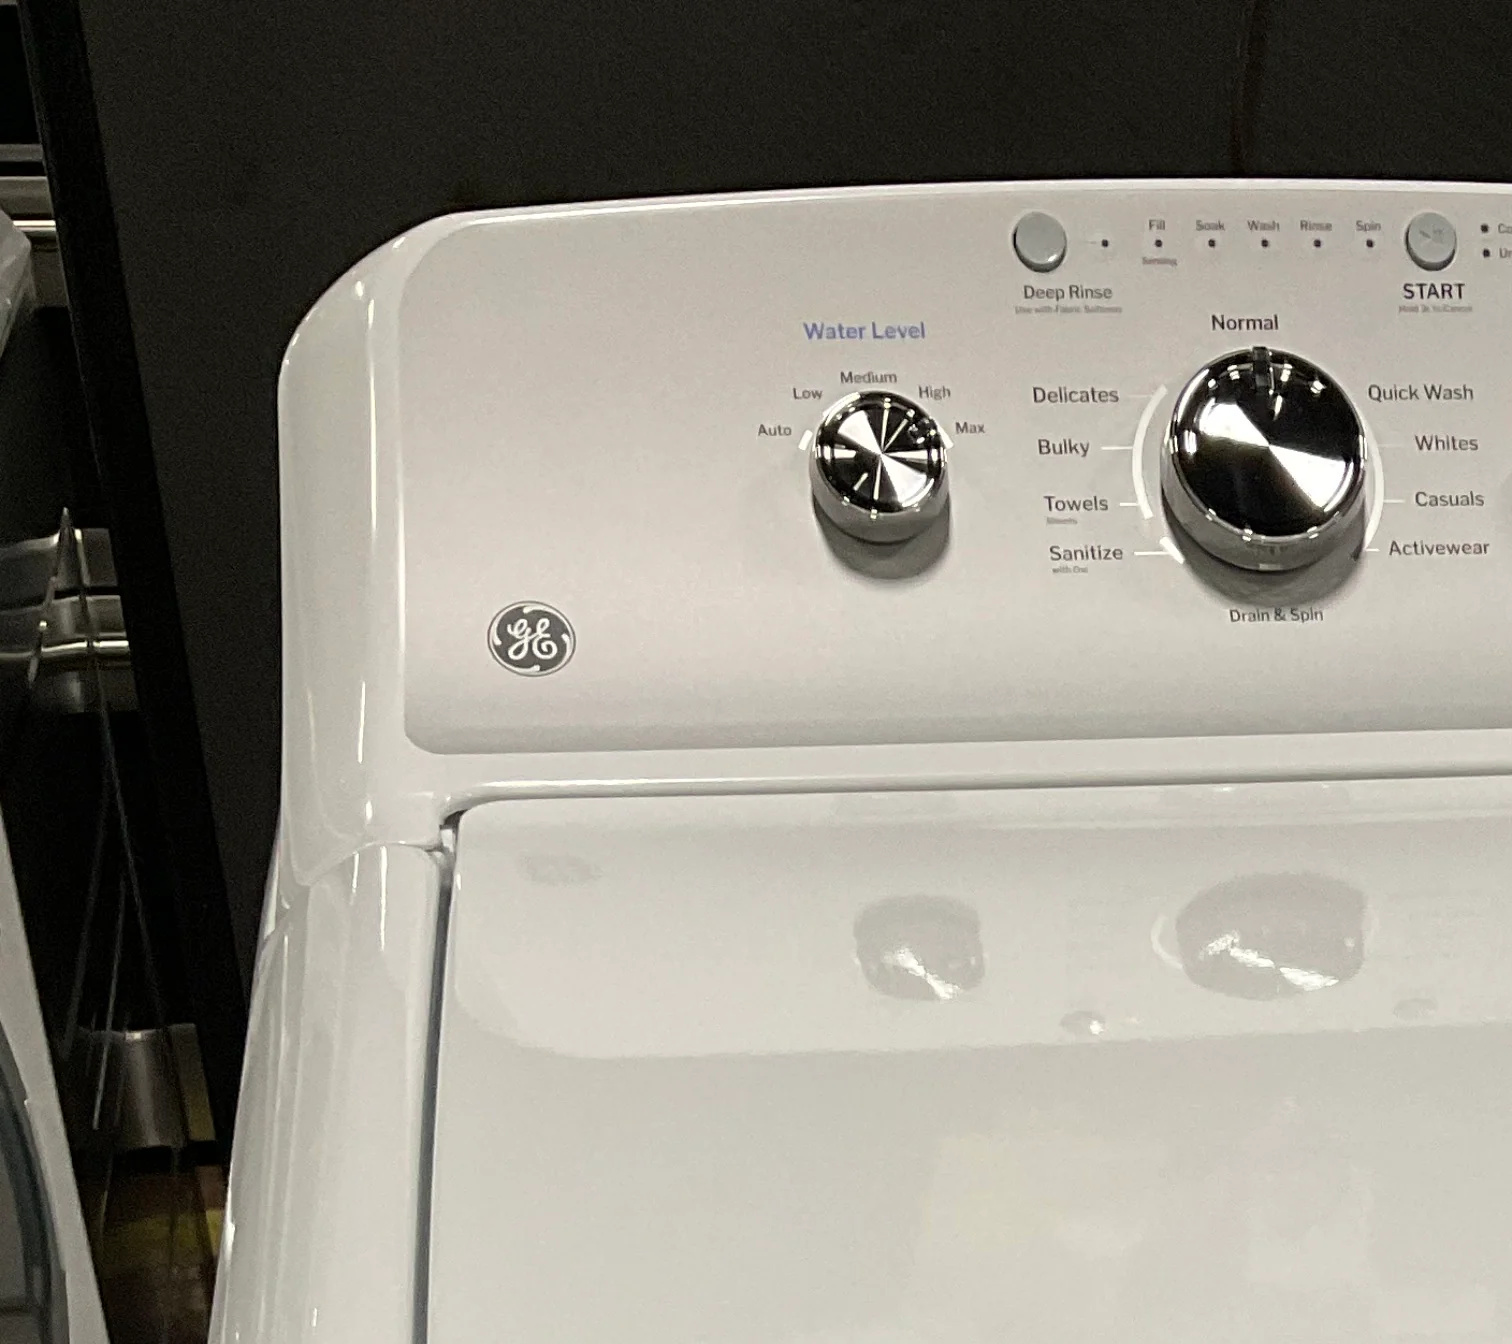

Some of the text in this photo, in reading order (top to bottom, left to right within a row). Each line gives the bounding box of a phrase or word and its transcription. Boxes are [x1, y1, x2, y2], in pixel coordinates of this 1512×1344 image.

[1148, 219, 1166, 231] Fill
[1195, 219, 1226, 232] Soak
[1247, 219, 1281, 232] Wash
[1299, 219, 1333, 232] Rinse
[1355, 219, 1382, 233] Spin
[1023, 283, 1114, 302] Deep Rinse
[1402, 283, 1466, 300] START
[802, 321, 927, 341] Water Level
[1210, 314, 1280, 332] Normal
[839, 371, 898, 385] Medium
[792, 388, 824, 401] Low
[918, 385, 952, 400] High
[1032, 386, 1120, 405] Delicates
[1367, 384, 1475, 402] Quick Wash
[757, 424, 793, 438] Auto
[954, 422, 986, 436] Max
[1037, 438, 1091, 458] Bulky
[1414, 435, 1480, 452] Whites
[1043, 495, 1109, 512] Towels
[1414, 491, 1486, 508] Casuals
[1048, 544, 1124, 562] Sanitize
[1388, 540, 1491, 556] Activewear
[1229, 608, 1325, 625] Drain & Spin
[506, 617, 559, 661] GE
